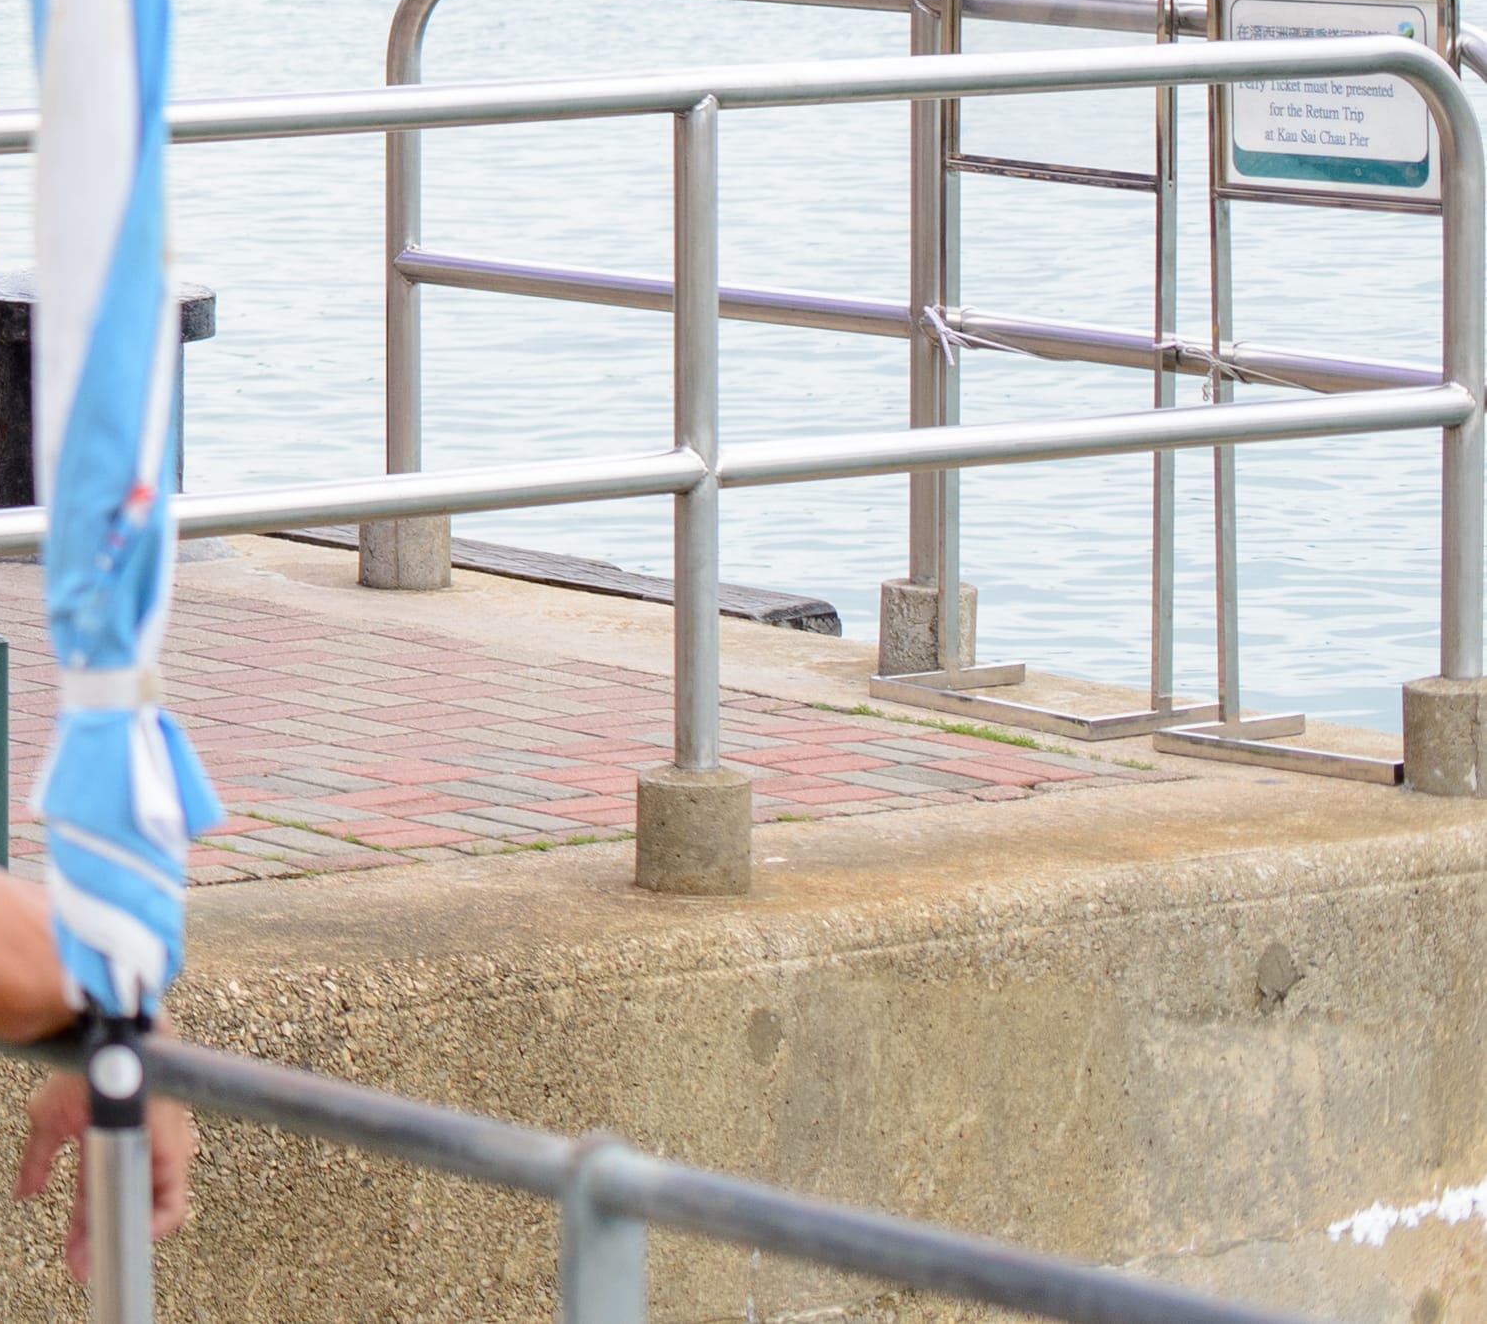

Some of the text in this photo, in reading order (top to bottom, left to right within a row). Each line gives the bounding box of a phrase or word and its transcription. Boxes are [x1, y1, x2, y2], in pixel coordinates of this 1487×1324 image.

[1270, 79, 1300, 92] Ticket
[1304, 81, 1328, 94] must
[1331, 81, 1343, 95] be
[1346, 83, 1394, 98] presented
[1270, 102, 1364, 123] for the Return Trip
[1265, 128, 1370, 147] at Kau Sai Chau Pier
